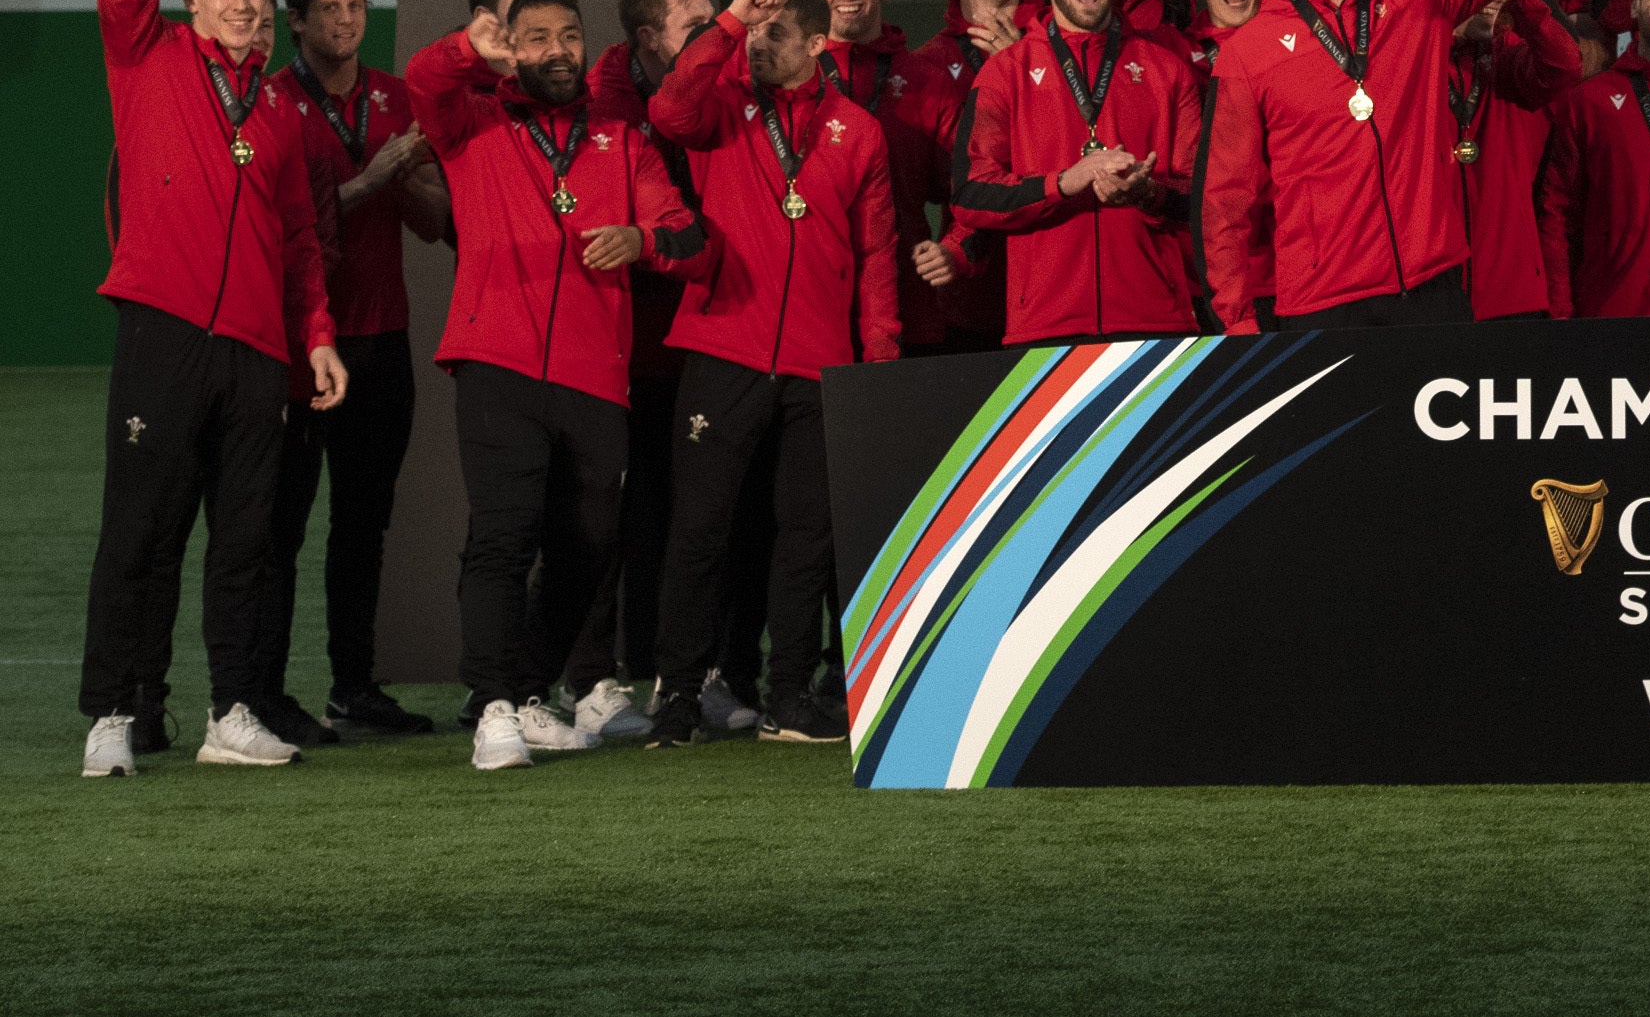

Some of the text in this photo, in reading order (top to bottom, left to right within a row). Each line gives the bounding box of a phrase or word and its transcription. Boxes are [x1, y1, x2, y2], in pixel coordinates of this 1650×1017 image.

[1317, 28, 1346, 66] GUINNESS
[1065, 68, 1086, 106] GUINNESS
[767, 116, 788, 159] GUINNESS
